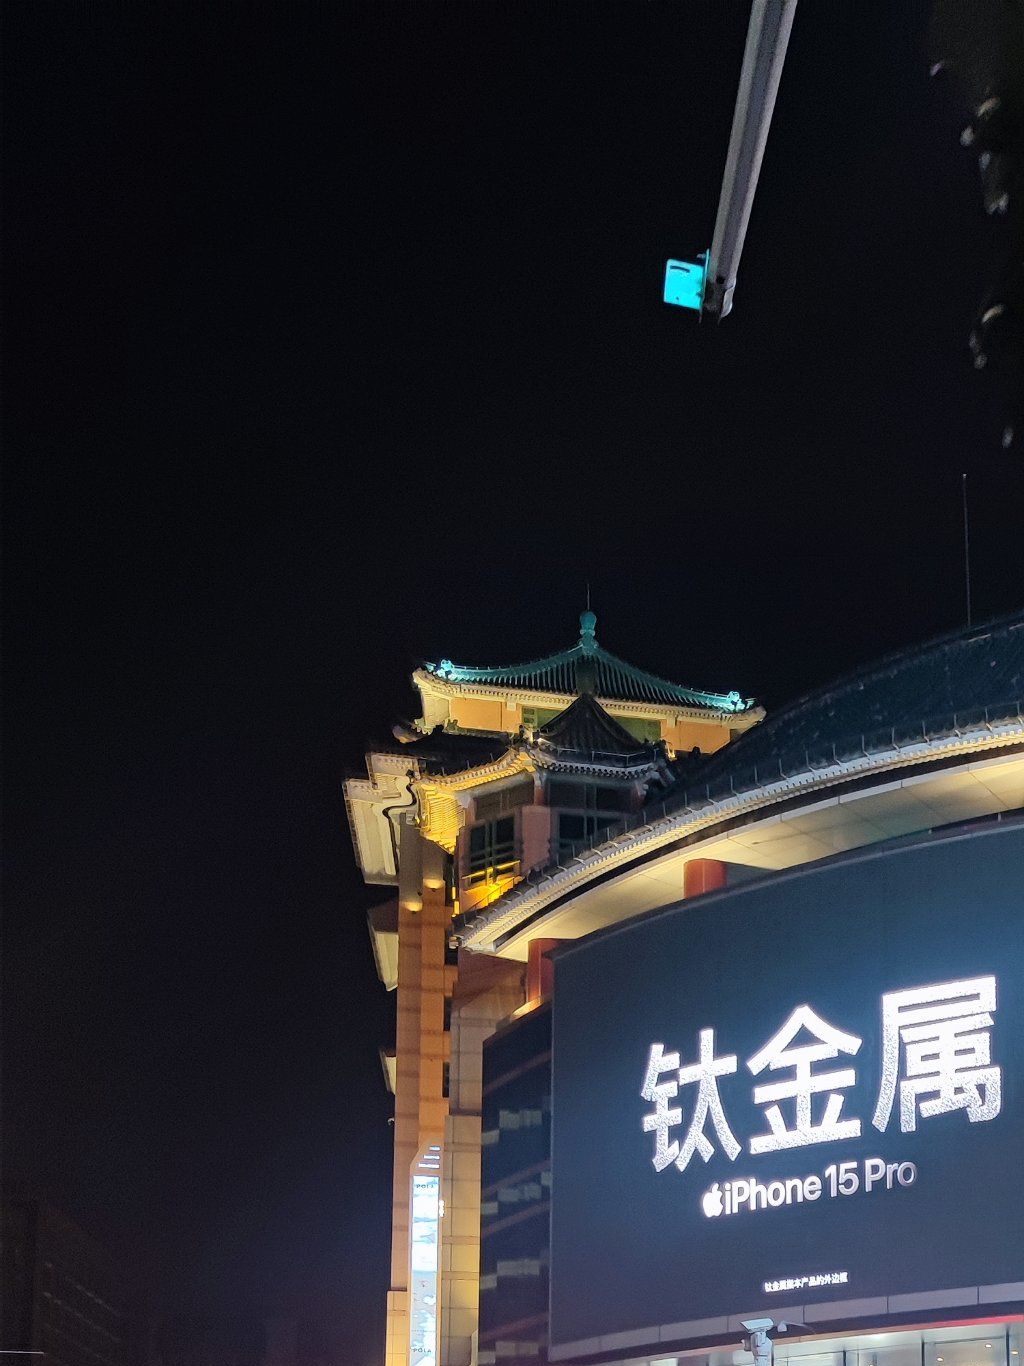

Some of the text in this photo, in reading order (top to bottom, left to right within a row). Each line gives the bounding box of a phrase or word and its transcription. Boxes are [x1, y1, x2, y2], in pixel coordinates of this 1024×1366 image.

[641, 975, 1001, 1172] 钛金属
[725, 1158, 918, 1215] iPhone 15 Pro
